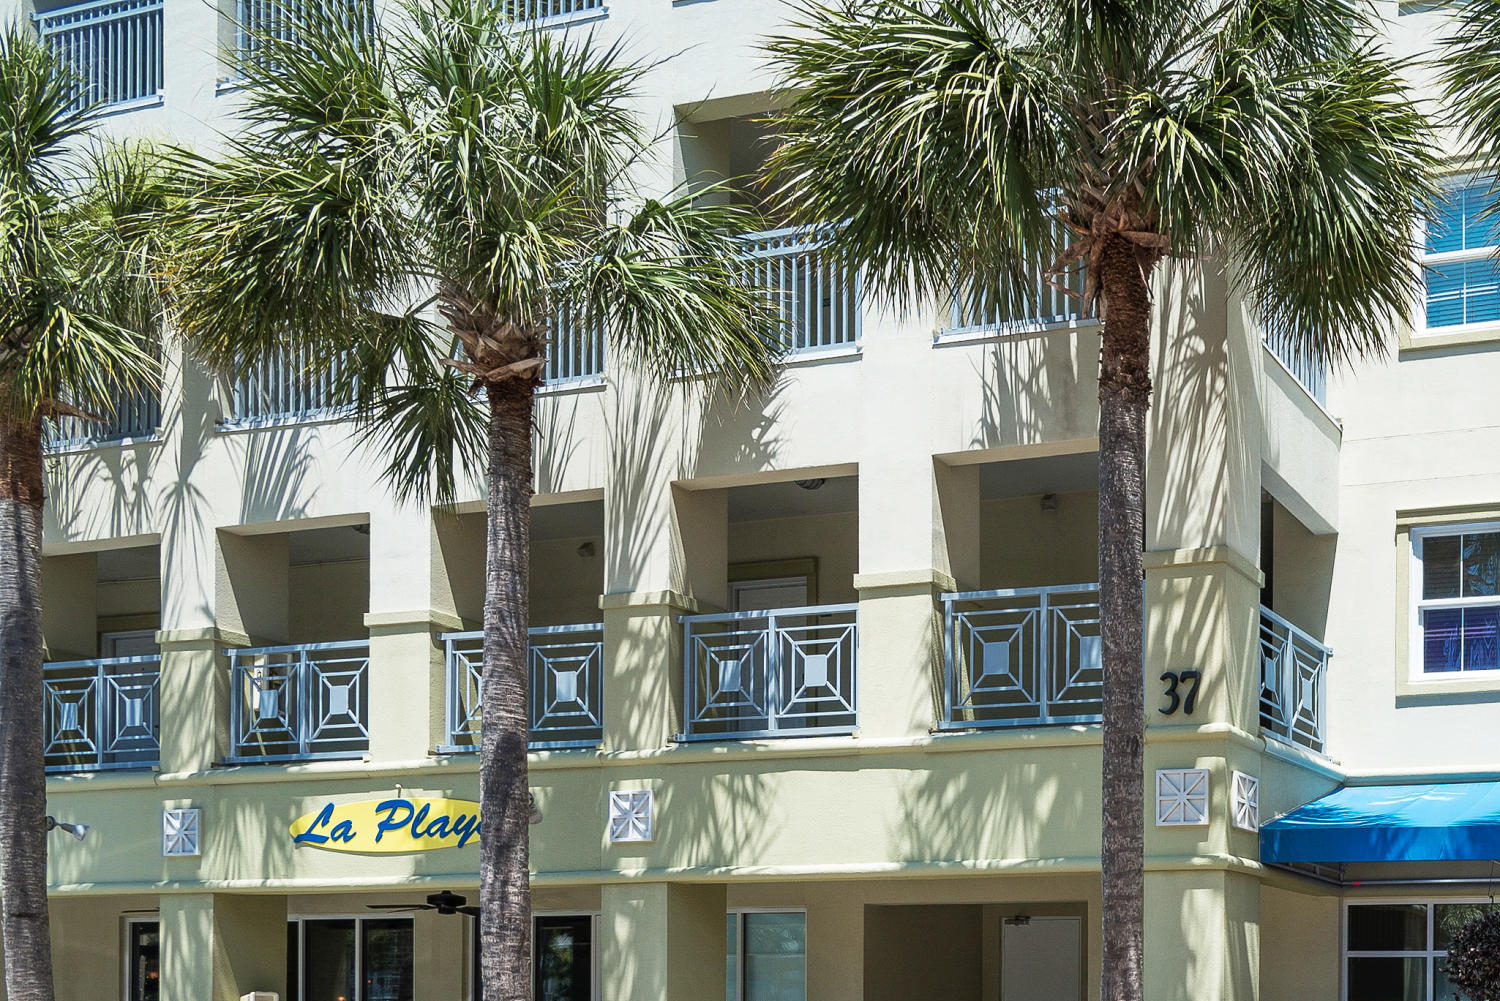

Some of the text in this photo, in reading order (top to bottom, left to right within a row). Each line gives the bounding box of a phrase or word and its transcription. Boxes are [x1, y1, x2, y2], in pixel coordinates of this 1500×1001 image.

[1158, 670, 1201, 715] 37
[293, 799, 481, 848] La Play
